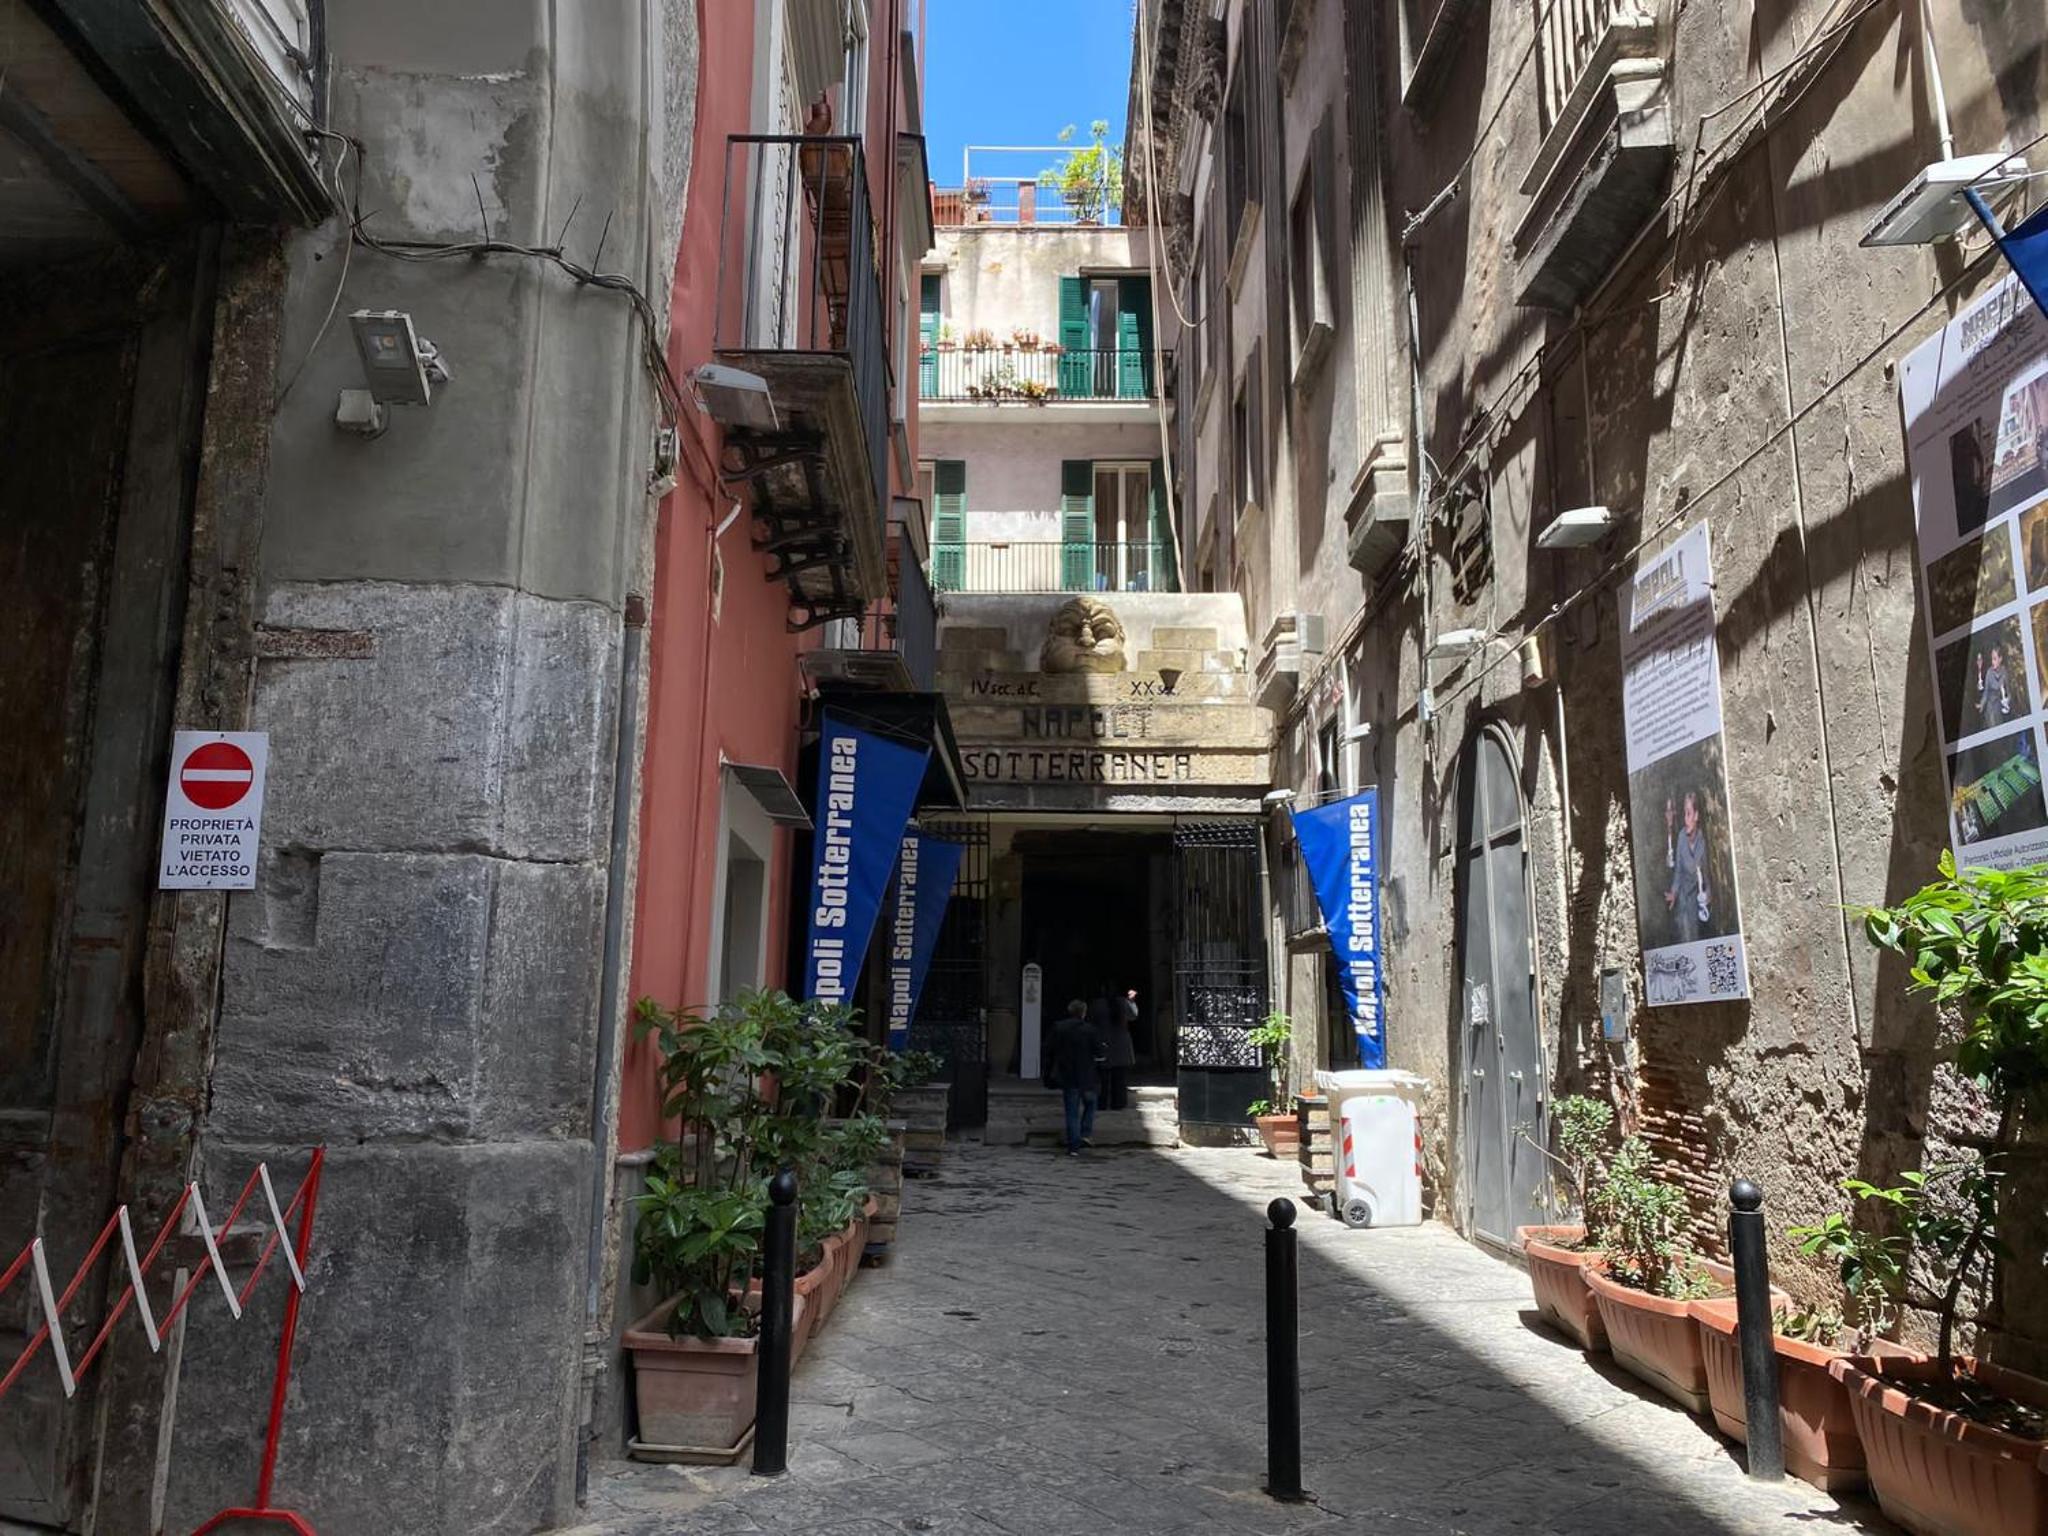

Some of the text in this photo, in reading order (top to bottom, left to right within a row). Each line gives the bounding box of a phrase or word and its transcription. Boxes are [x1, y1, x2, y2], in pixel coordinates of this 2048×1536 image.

[1130, 679, 1155, 697] XX
[1023, 704, 1151, 738] NAPOLI
[962, 752, 1191, 781] SOTTERRANEA
[170, 817, 254, 831] PROPRIETÀ
[816, 737, 857, 928] Sotterranea
[180, 834, 240, 845] PRIVATA
[180, 850, 240, 862] VIETATO
[166, 865, 250, 877] L'ACCESSO
[1348, 803, 1378, 1036] Napoli Sotterranea
[890, 837, 919, 1030] Napoli Sotterranea
